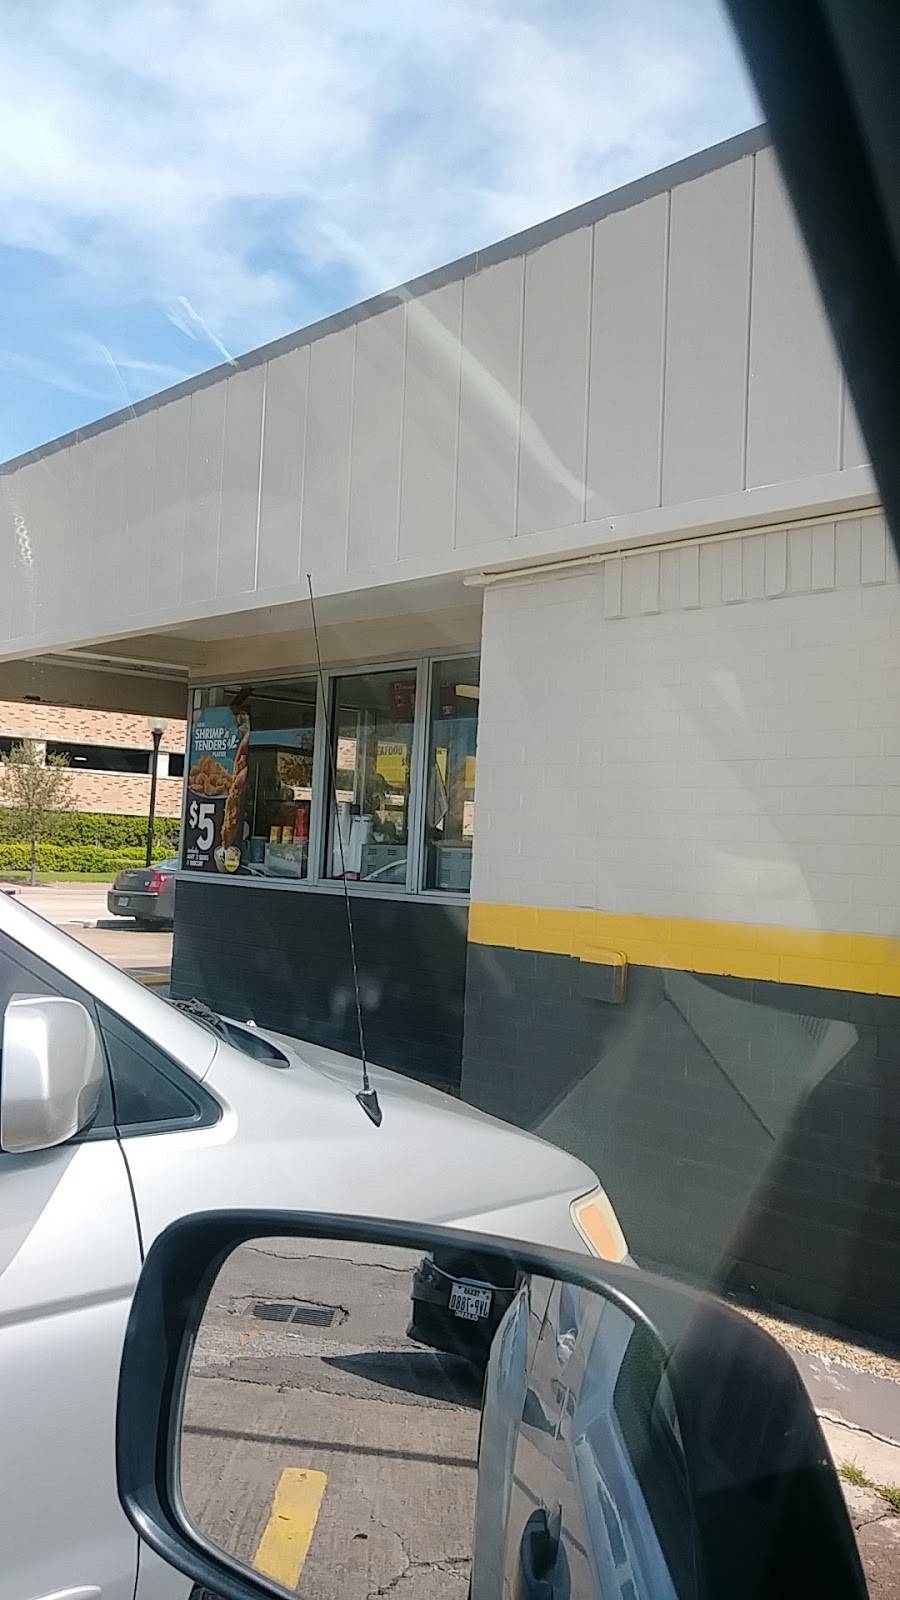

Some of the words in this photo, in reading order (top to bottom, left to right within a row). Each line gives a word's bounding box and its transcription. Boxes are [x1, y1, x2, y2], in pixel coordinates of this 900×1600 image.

[195, 727, 224, 739] SHRIMP
[194, 739, 227, 751] TENDERS
[189, 800, 215, 851] $5
